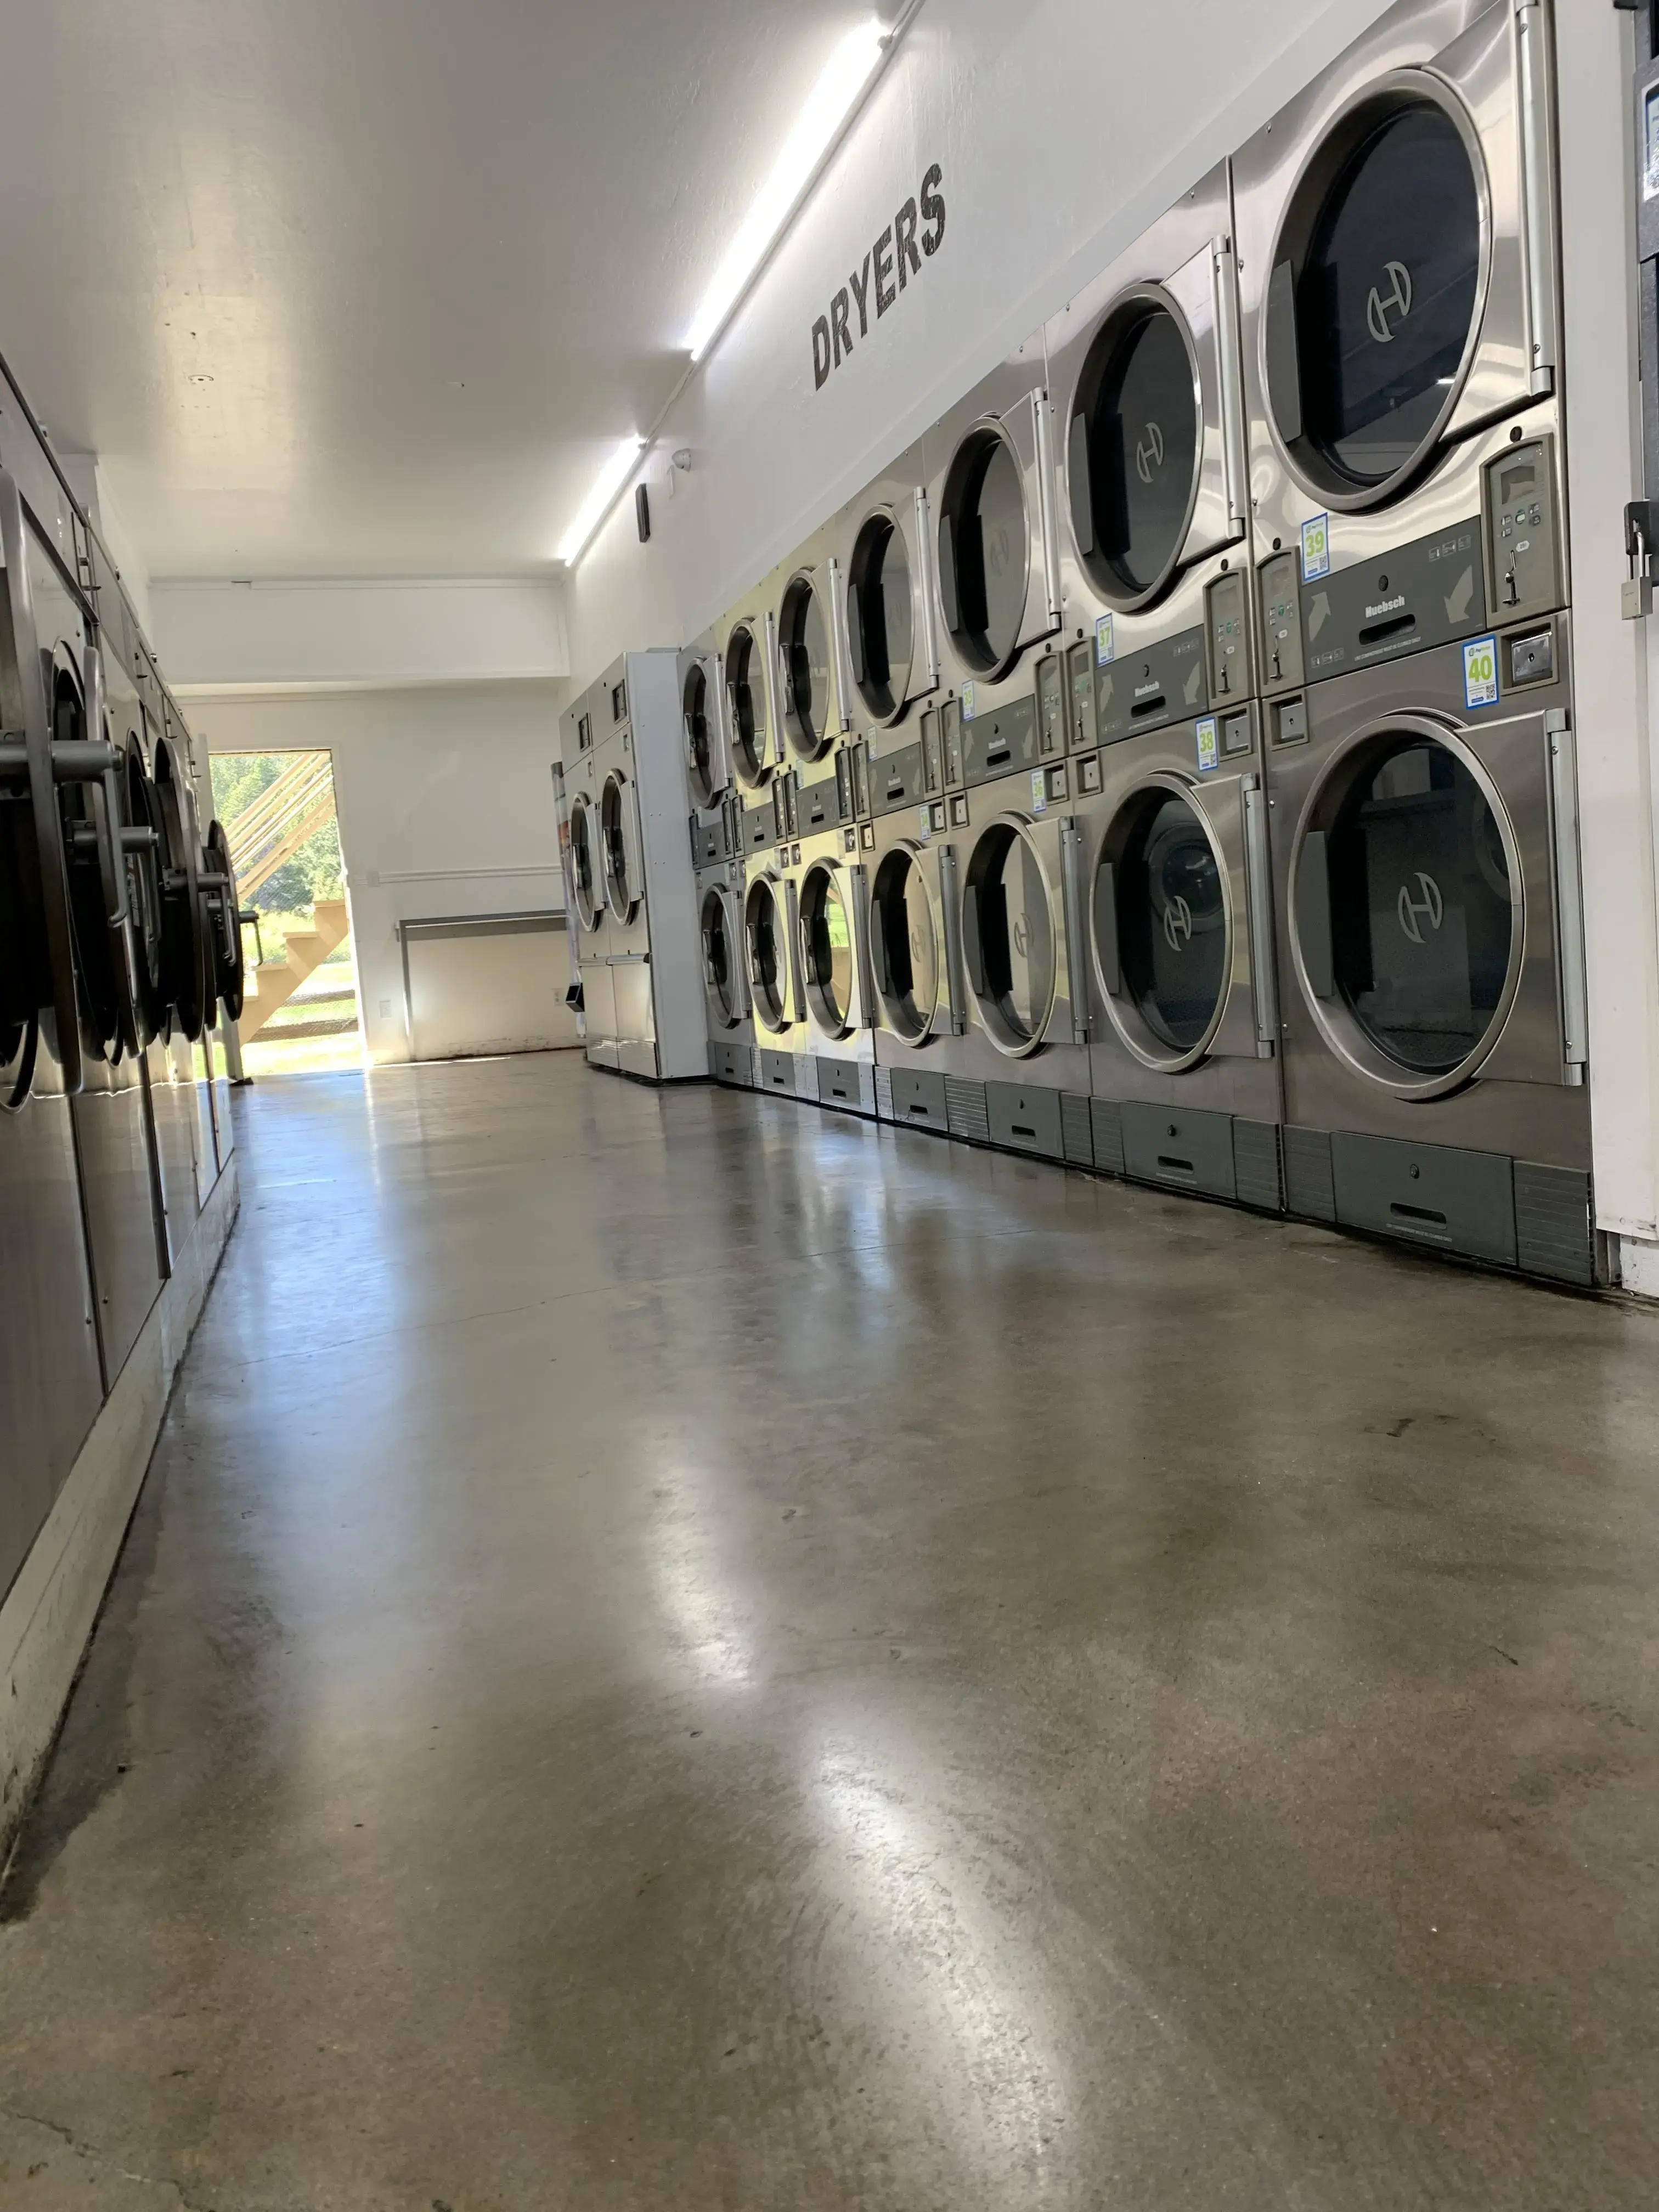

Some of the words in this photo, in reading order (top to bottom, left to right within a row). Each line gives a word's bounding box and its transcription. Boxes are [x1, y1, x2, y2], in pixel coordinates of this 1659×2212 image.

[811, 162, 946, 391] DRYERS
[1306, 531, 1324, 557] 39
[1365, 595, 1405, 618] Huebsch
[1099, 626, 1110, 647] 37
[1469, 655, 1492, 682] 40
[1200, 731, 1214, 752] 38
